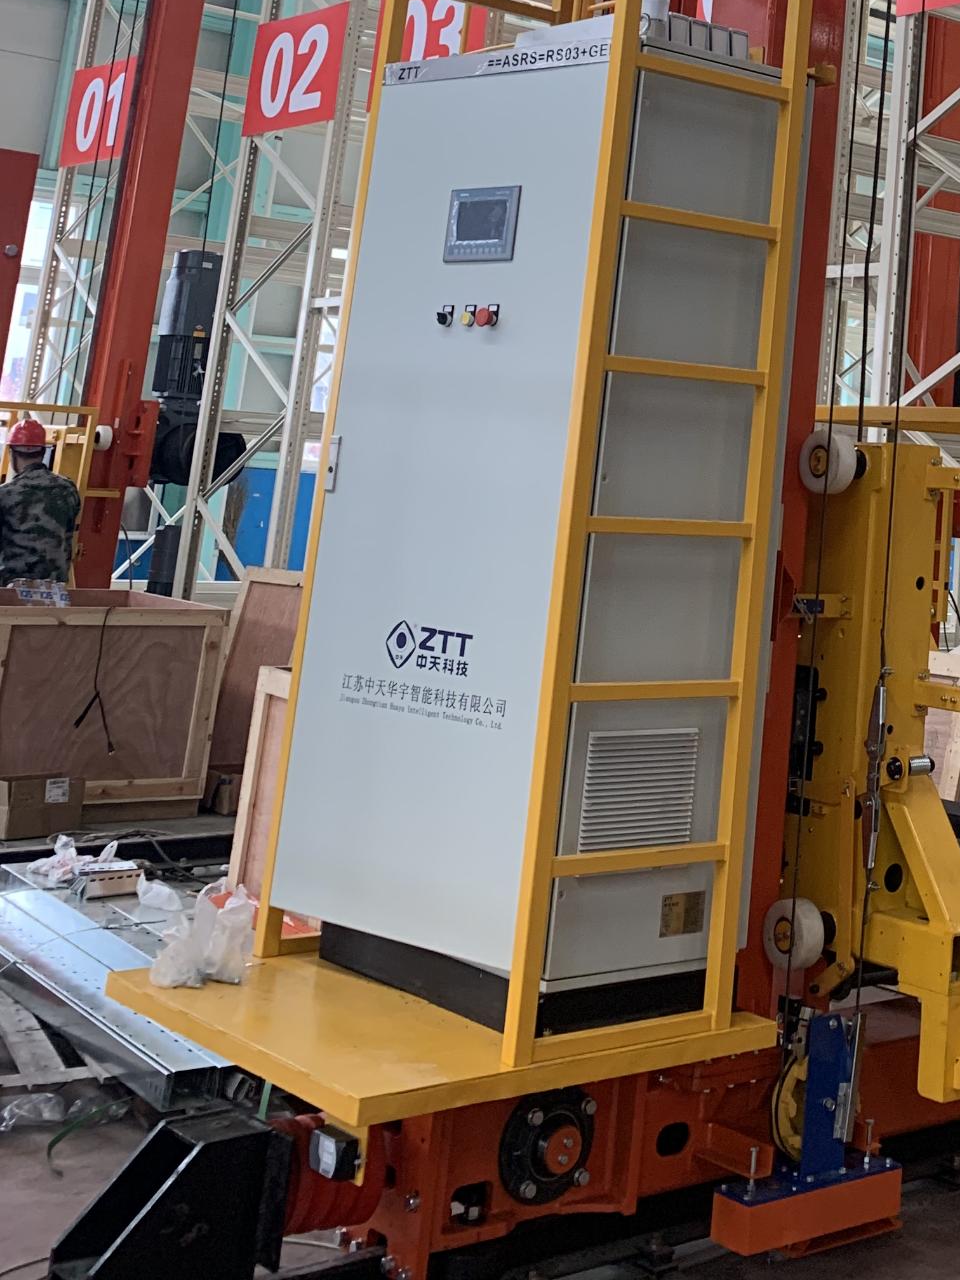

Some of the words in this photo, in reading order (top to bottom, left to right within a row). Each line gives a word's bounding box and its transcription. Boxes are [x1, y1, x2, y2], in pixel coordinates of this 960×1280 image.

[260, 23, 329, 119] 02
[487, 43, 612, 68] ==ASRS=RS03+GE
[398, 67, 421, 80] ZTT
[76, 72, 127, 152] 01
[418, 626, 473, 657] ZTT
[416, 654, 469, 677] 中天科技
[342, 673, 507, 718] 江苏中天华宇智能科技有限公司
